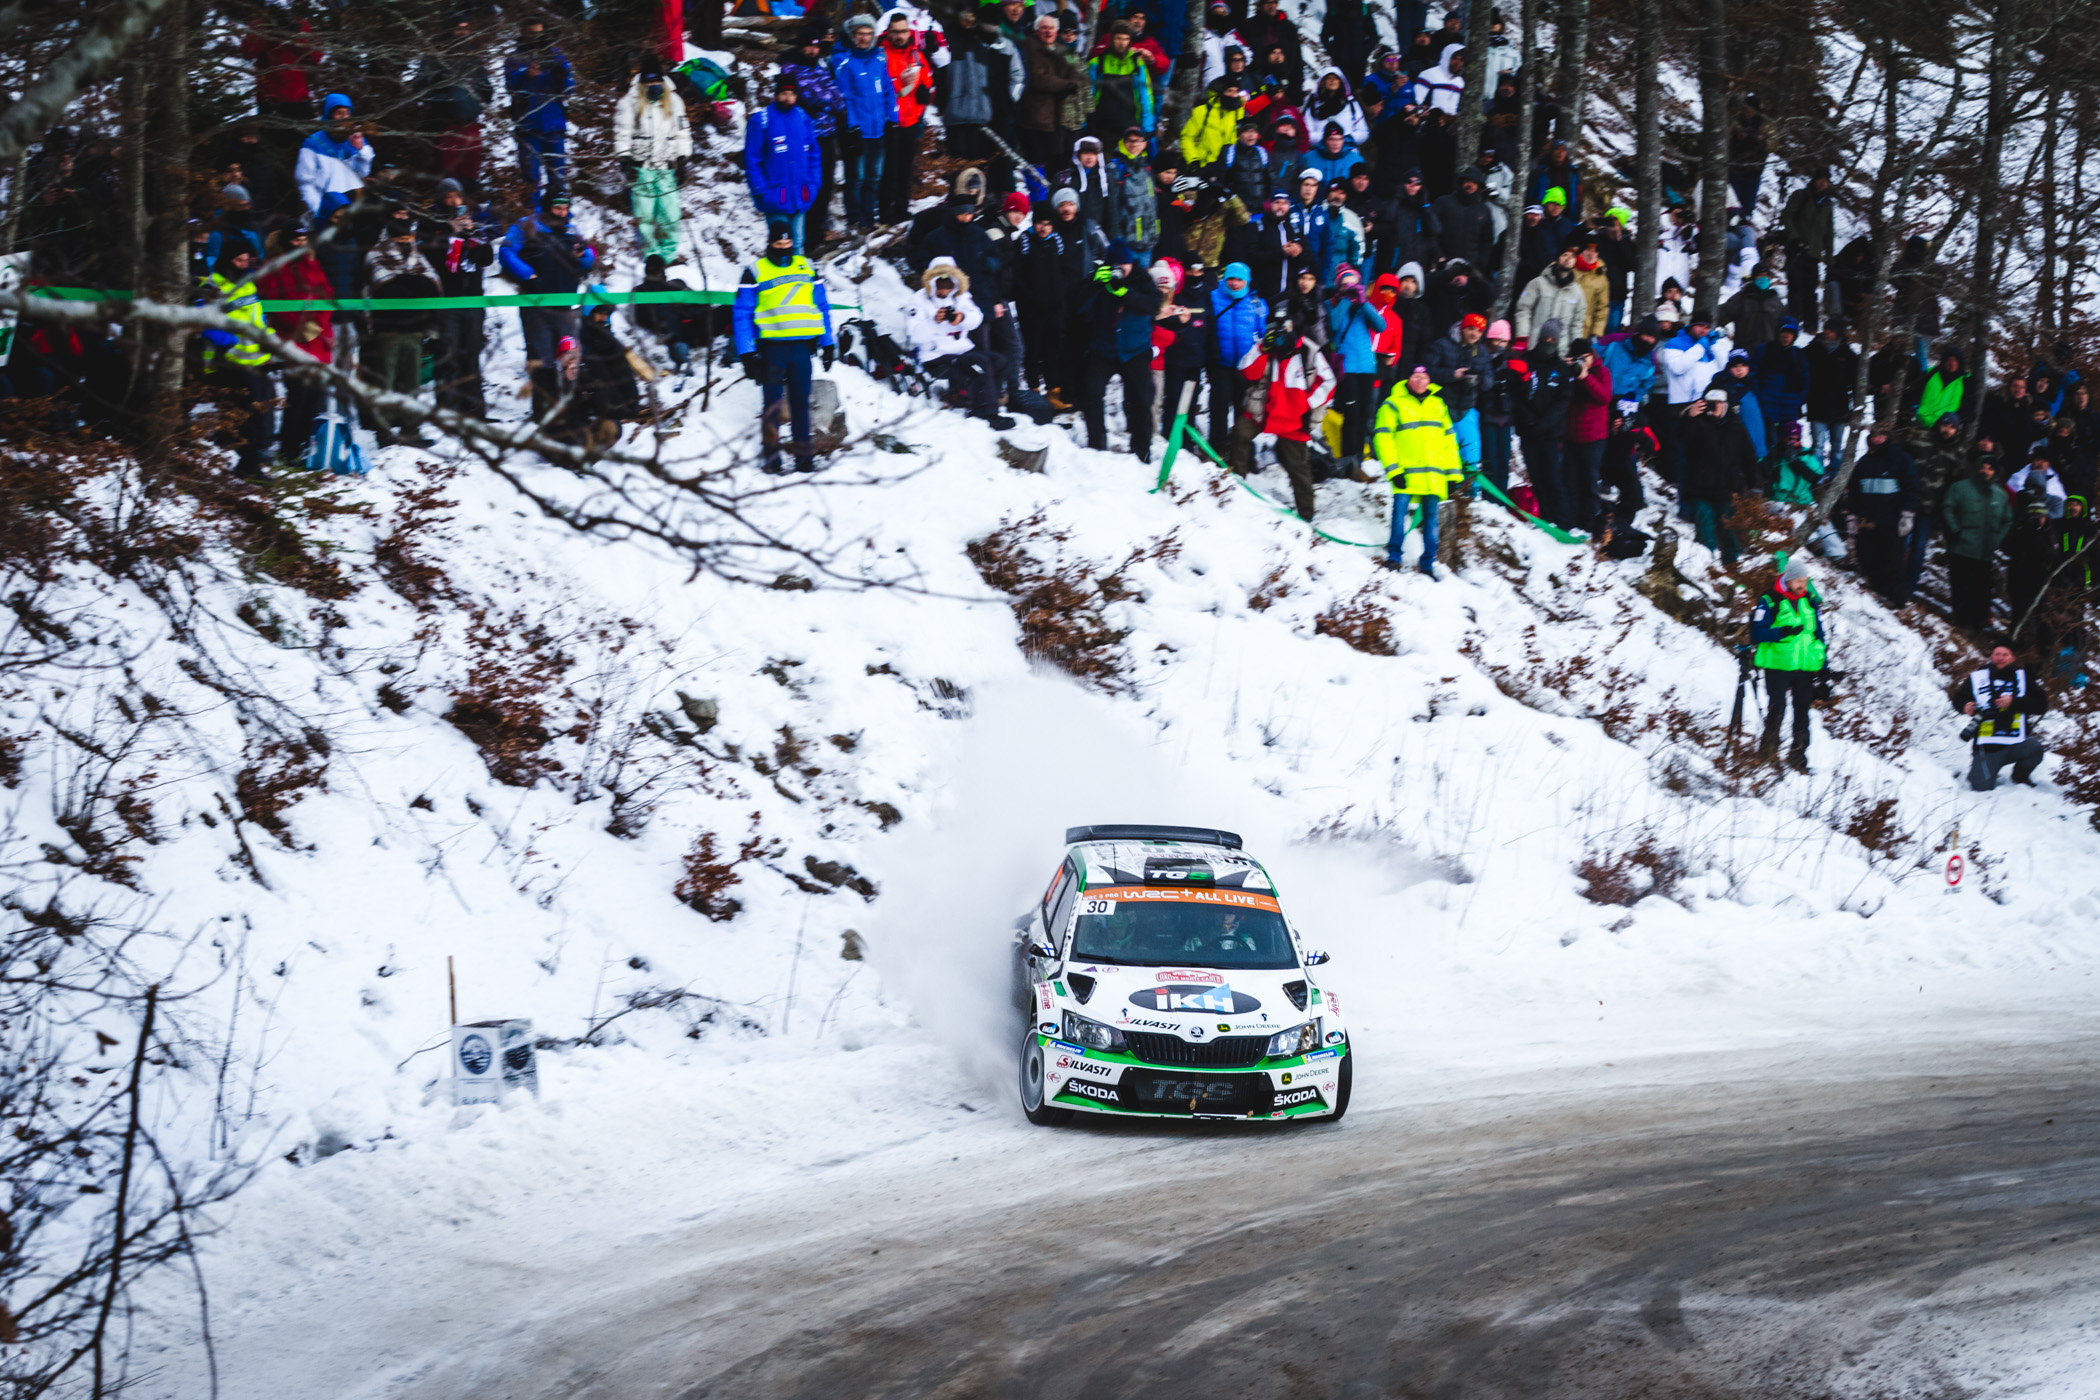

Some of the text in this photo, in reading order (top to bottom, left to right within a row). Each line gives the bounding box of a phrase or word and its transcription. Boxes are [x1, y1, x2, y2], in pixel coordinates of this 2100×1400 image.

[1149, 869, 1209, 880] TGS
[1195, 892, 1222, 901] ALL
[1224, 893, 1256, 906] LIVE
[1087, 900, 1108, 914] 30
[1124, 1017, 1181, 1032] SILVASTI
[1062, 1057, 1112, 1077] SILVASTI
[1294, 1067, 1329, 1081] JOHN DEERE
[1068, 1079, 1120, 1101] ŠKODA
[1273, 1088, 1317, 1107] ŠKODA
